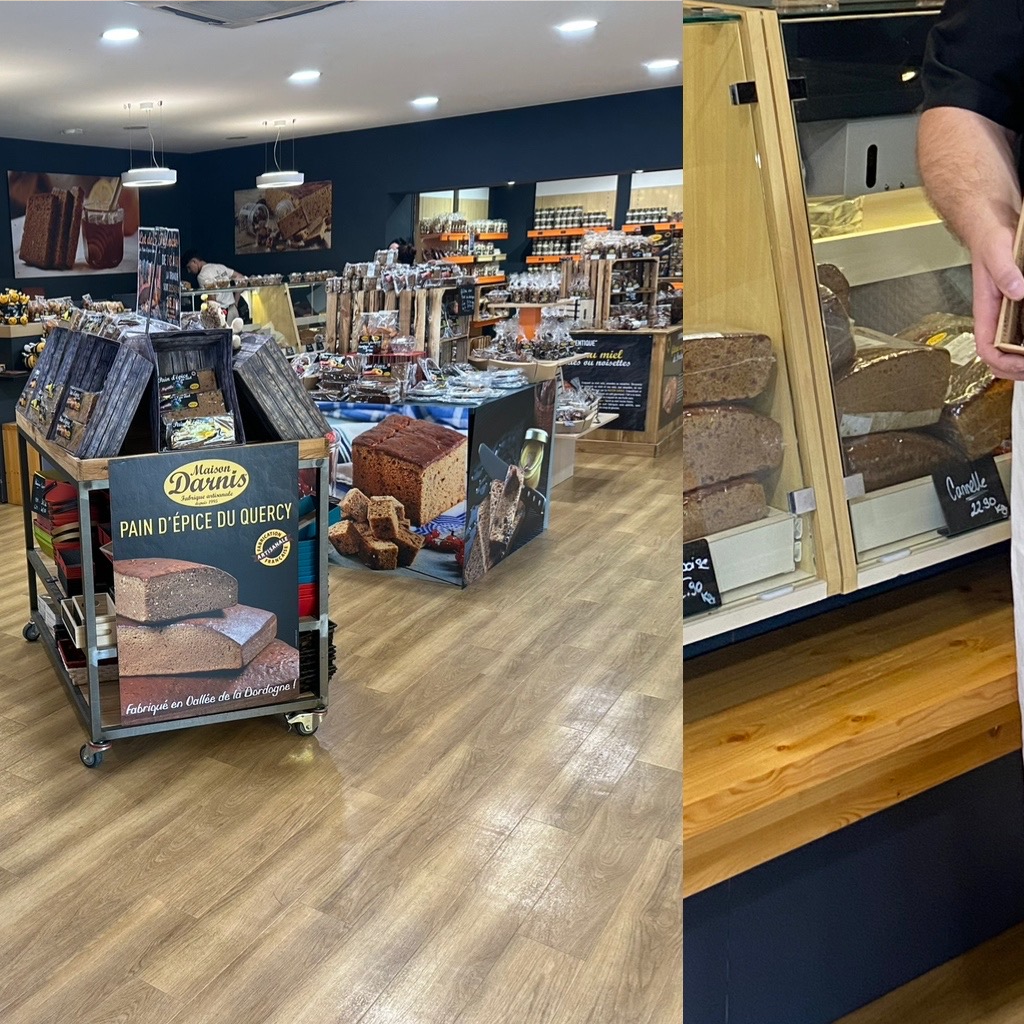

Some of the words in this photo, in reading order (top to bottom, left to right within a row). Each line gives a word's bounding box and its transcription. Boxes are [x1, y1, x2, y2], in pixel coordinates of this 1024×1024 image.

[595, 359, 632, 368] noisettes
[600, 349, 624, 360] miel
[190, 464, 231, 476] Maison
[168, 470, 248, 495] Darnis
[946, 471, 988, 501] Cannelle
[180, 494, 206, 502] Fabrique
[206, 491, 234, 499] artisanale
[120, 519, 153, 539] PAIN
[158, 512, 213, 536] D'ÉPICE
[217, 509, 236, 529] DU
[240, 502, 293, 526] QUERCY
[256, 531, 282, 552] FABRICATION
[257, 536, 289, 561] ARTISANALE
[264, 546, 289, 564] FRANÇAISE
[126, 699, 169, 716] Fabriqué
[171, 701, 183, 710] en
[218, 690, 230, 703] de
[232, 689, 242, 700] la
[244, 683, 291, 698] Dordogne
